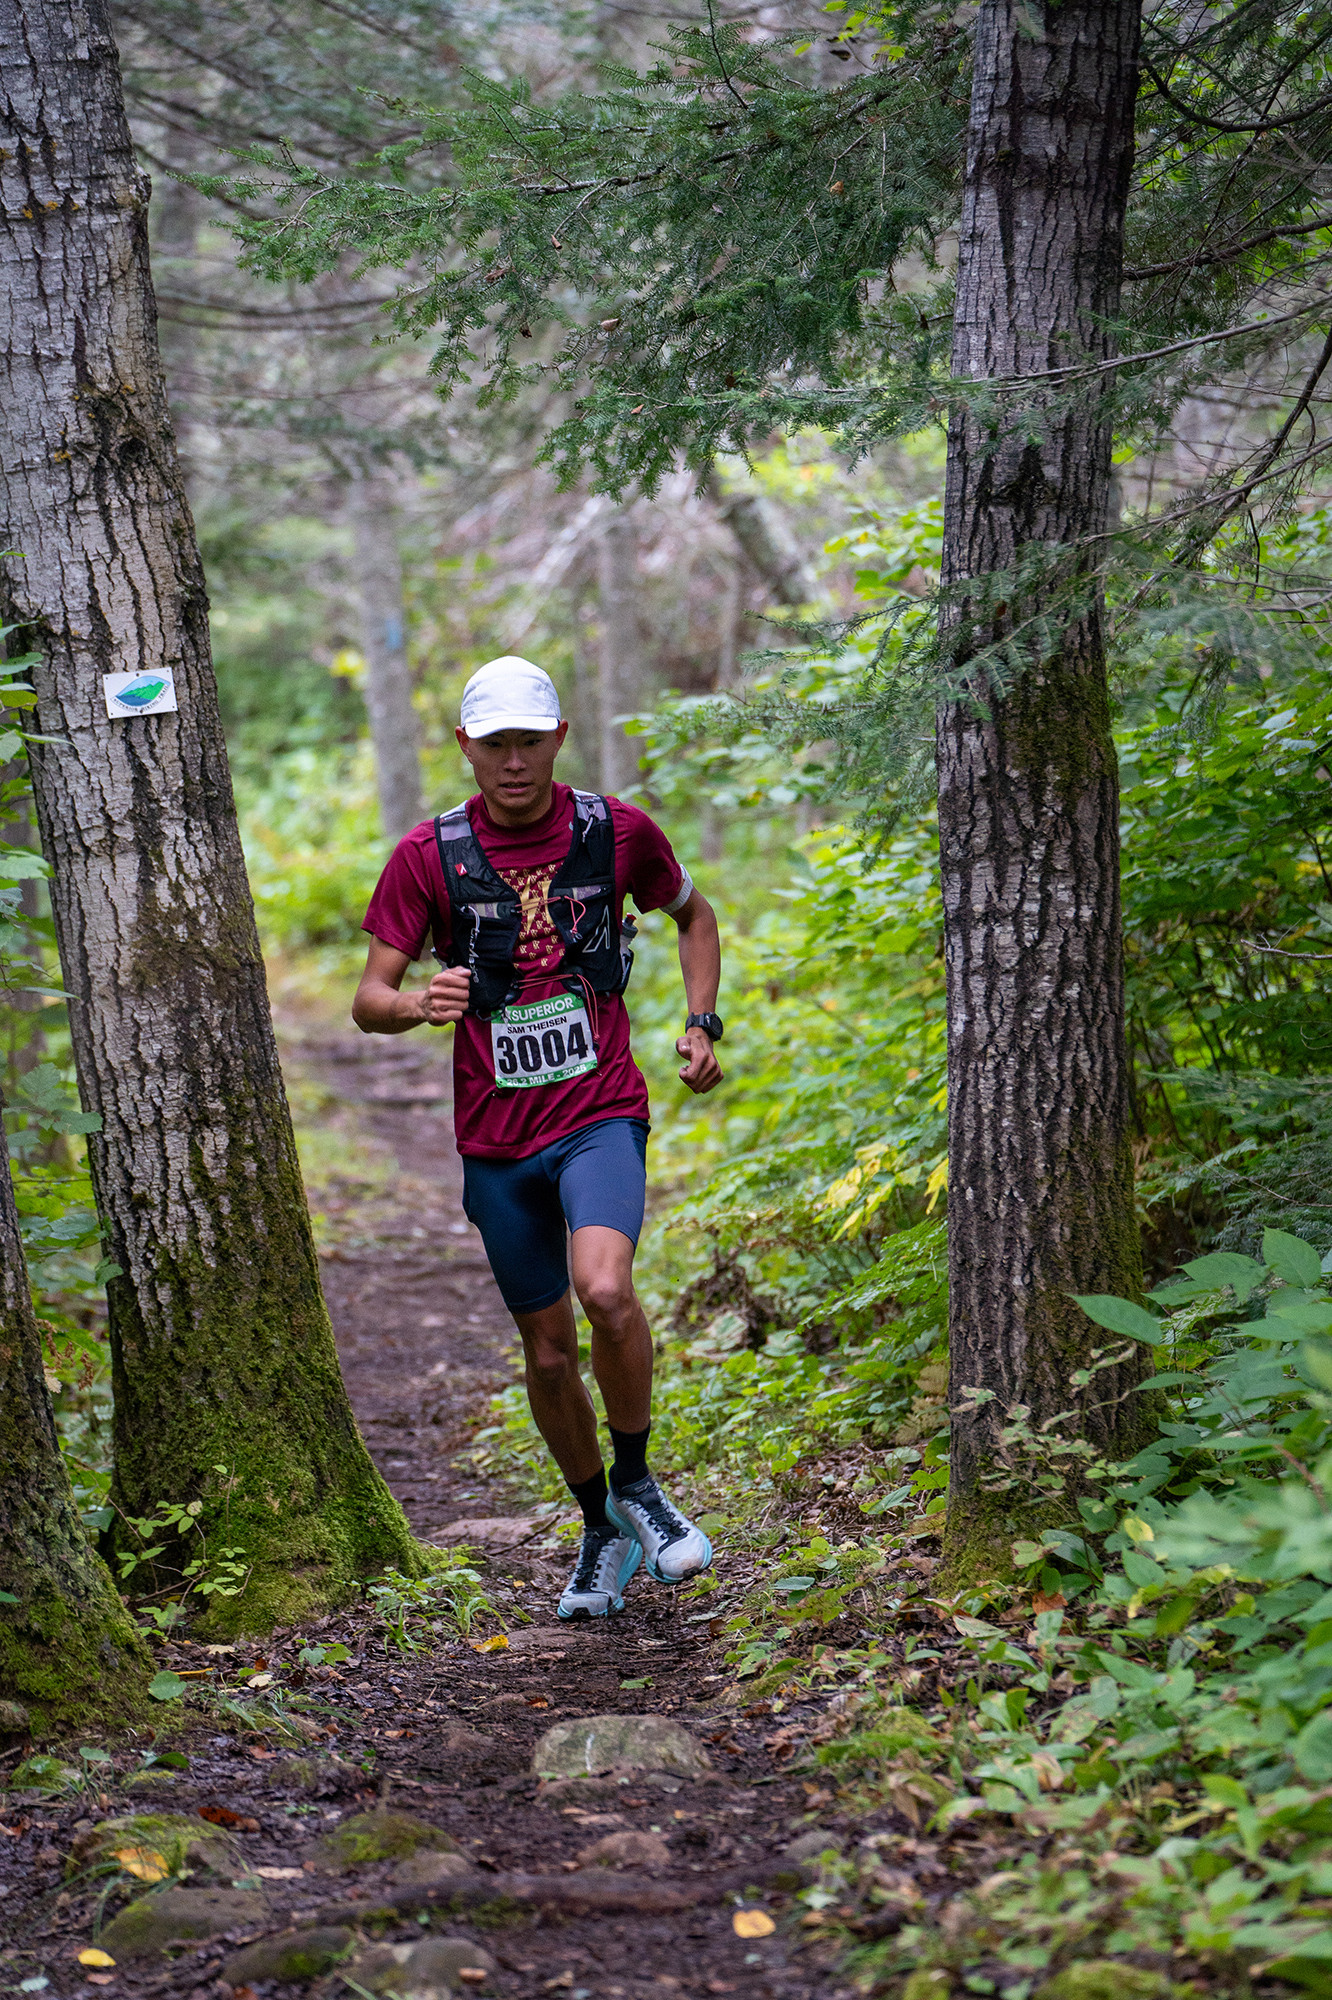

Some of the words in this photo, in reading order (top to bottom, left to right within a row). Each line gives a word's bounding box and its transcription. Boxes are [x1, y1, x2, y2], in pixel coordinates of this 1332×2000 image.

[511, 997, 574, 1022] SUPERIOR
[507, 1025, 526, 1034] SAM
[528, 1016, 567, 1032] THEISEN
[496, 1022, 588, 1074] 3004
[529, 1072, 555, 1085] MILE
